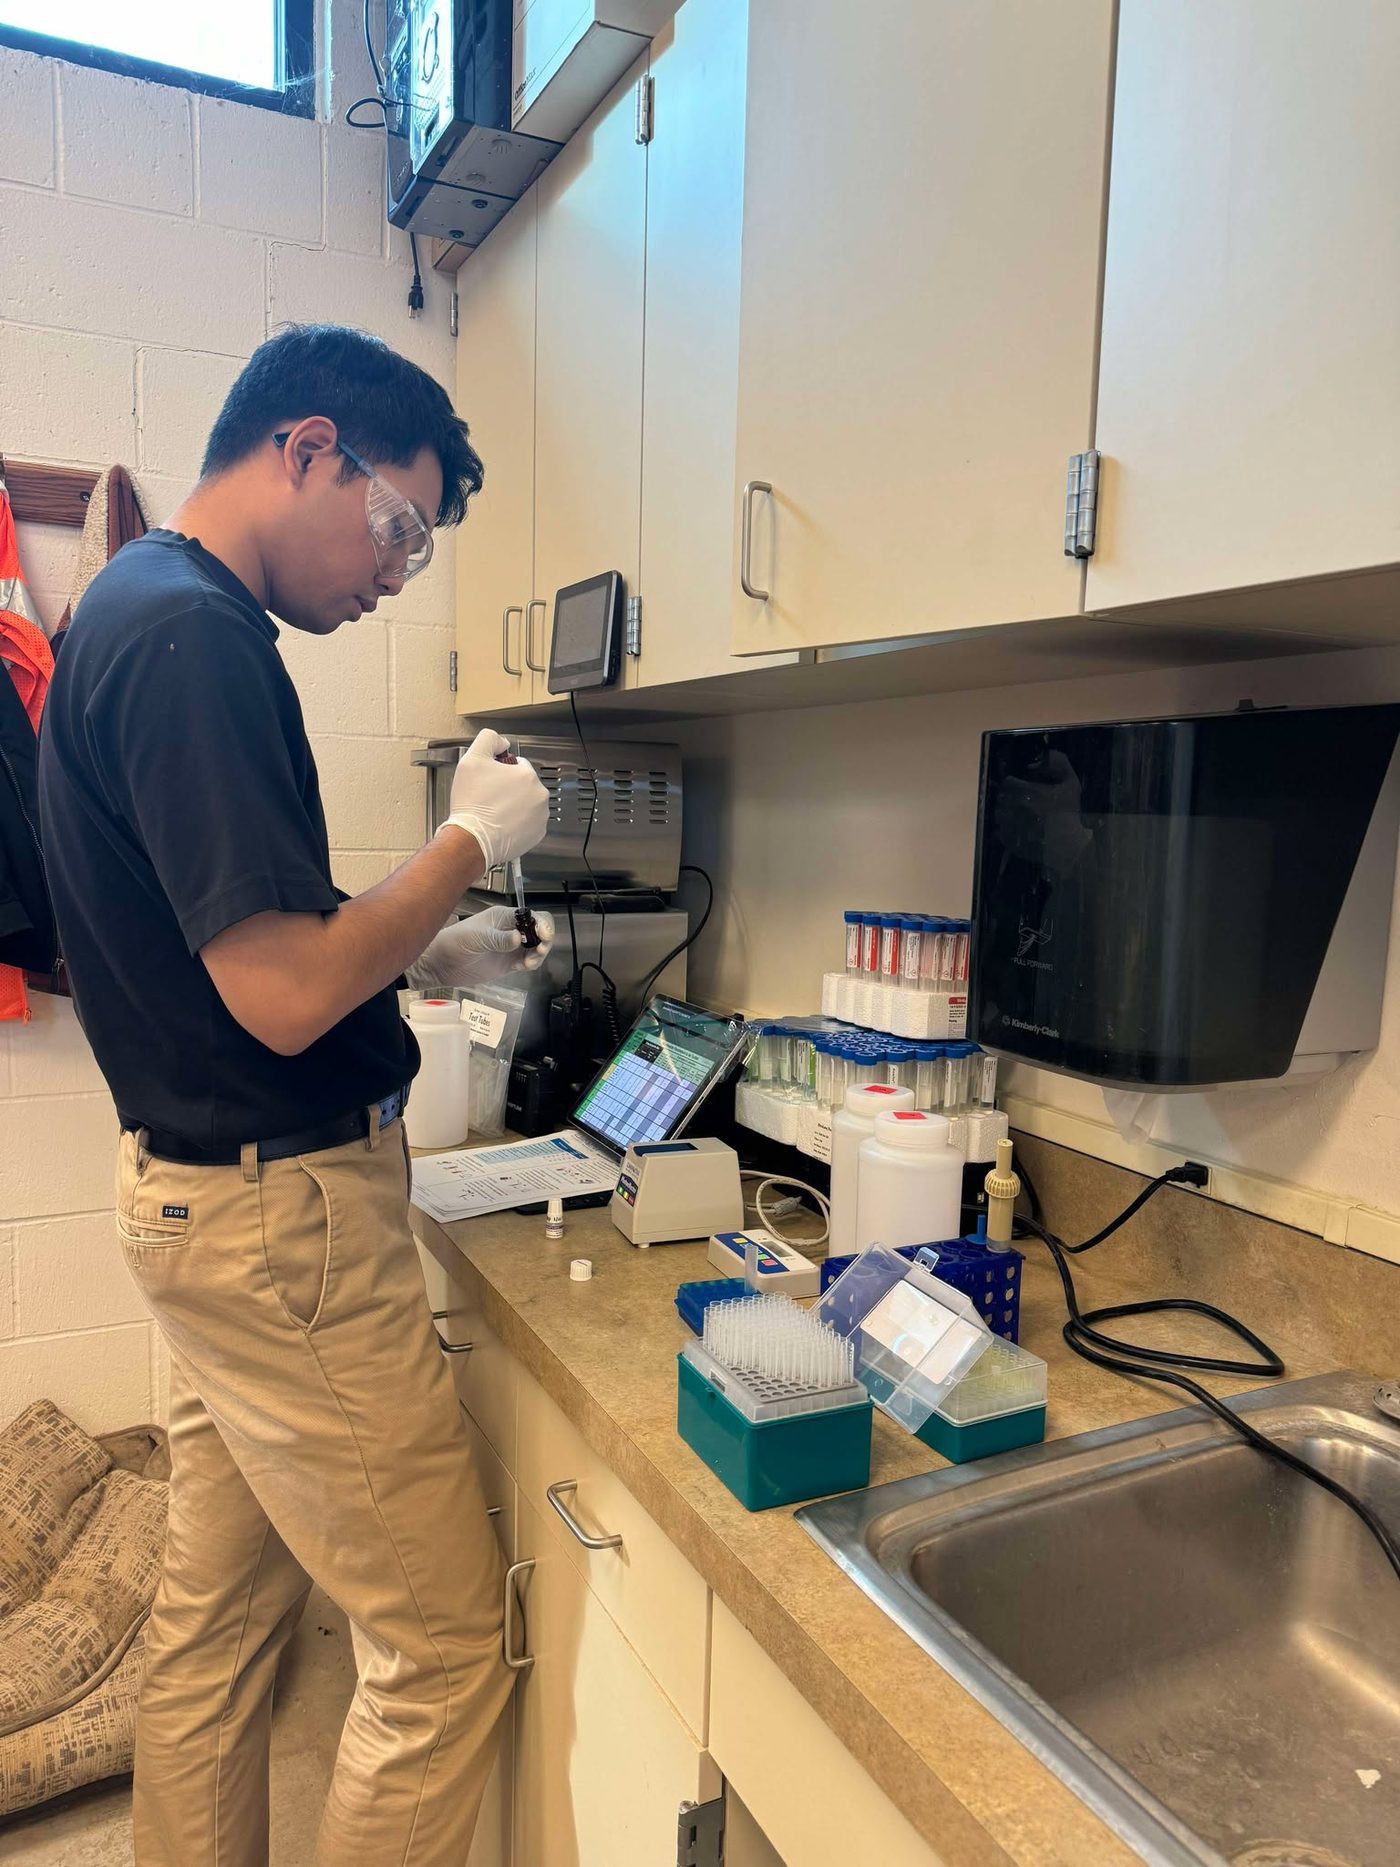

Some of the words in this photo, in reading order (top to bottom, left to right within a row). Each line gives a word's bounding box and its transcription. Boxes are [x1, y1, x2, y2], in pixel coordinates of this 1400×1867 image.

[469, 1012, 478, 1022] Test
[479, 1015, 490, 1027] Tubes
[1012, 1018, 1060, 1038] Kimberly-Clark
[165, 1208, 185, 1216] IZOD
